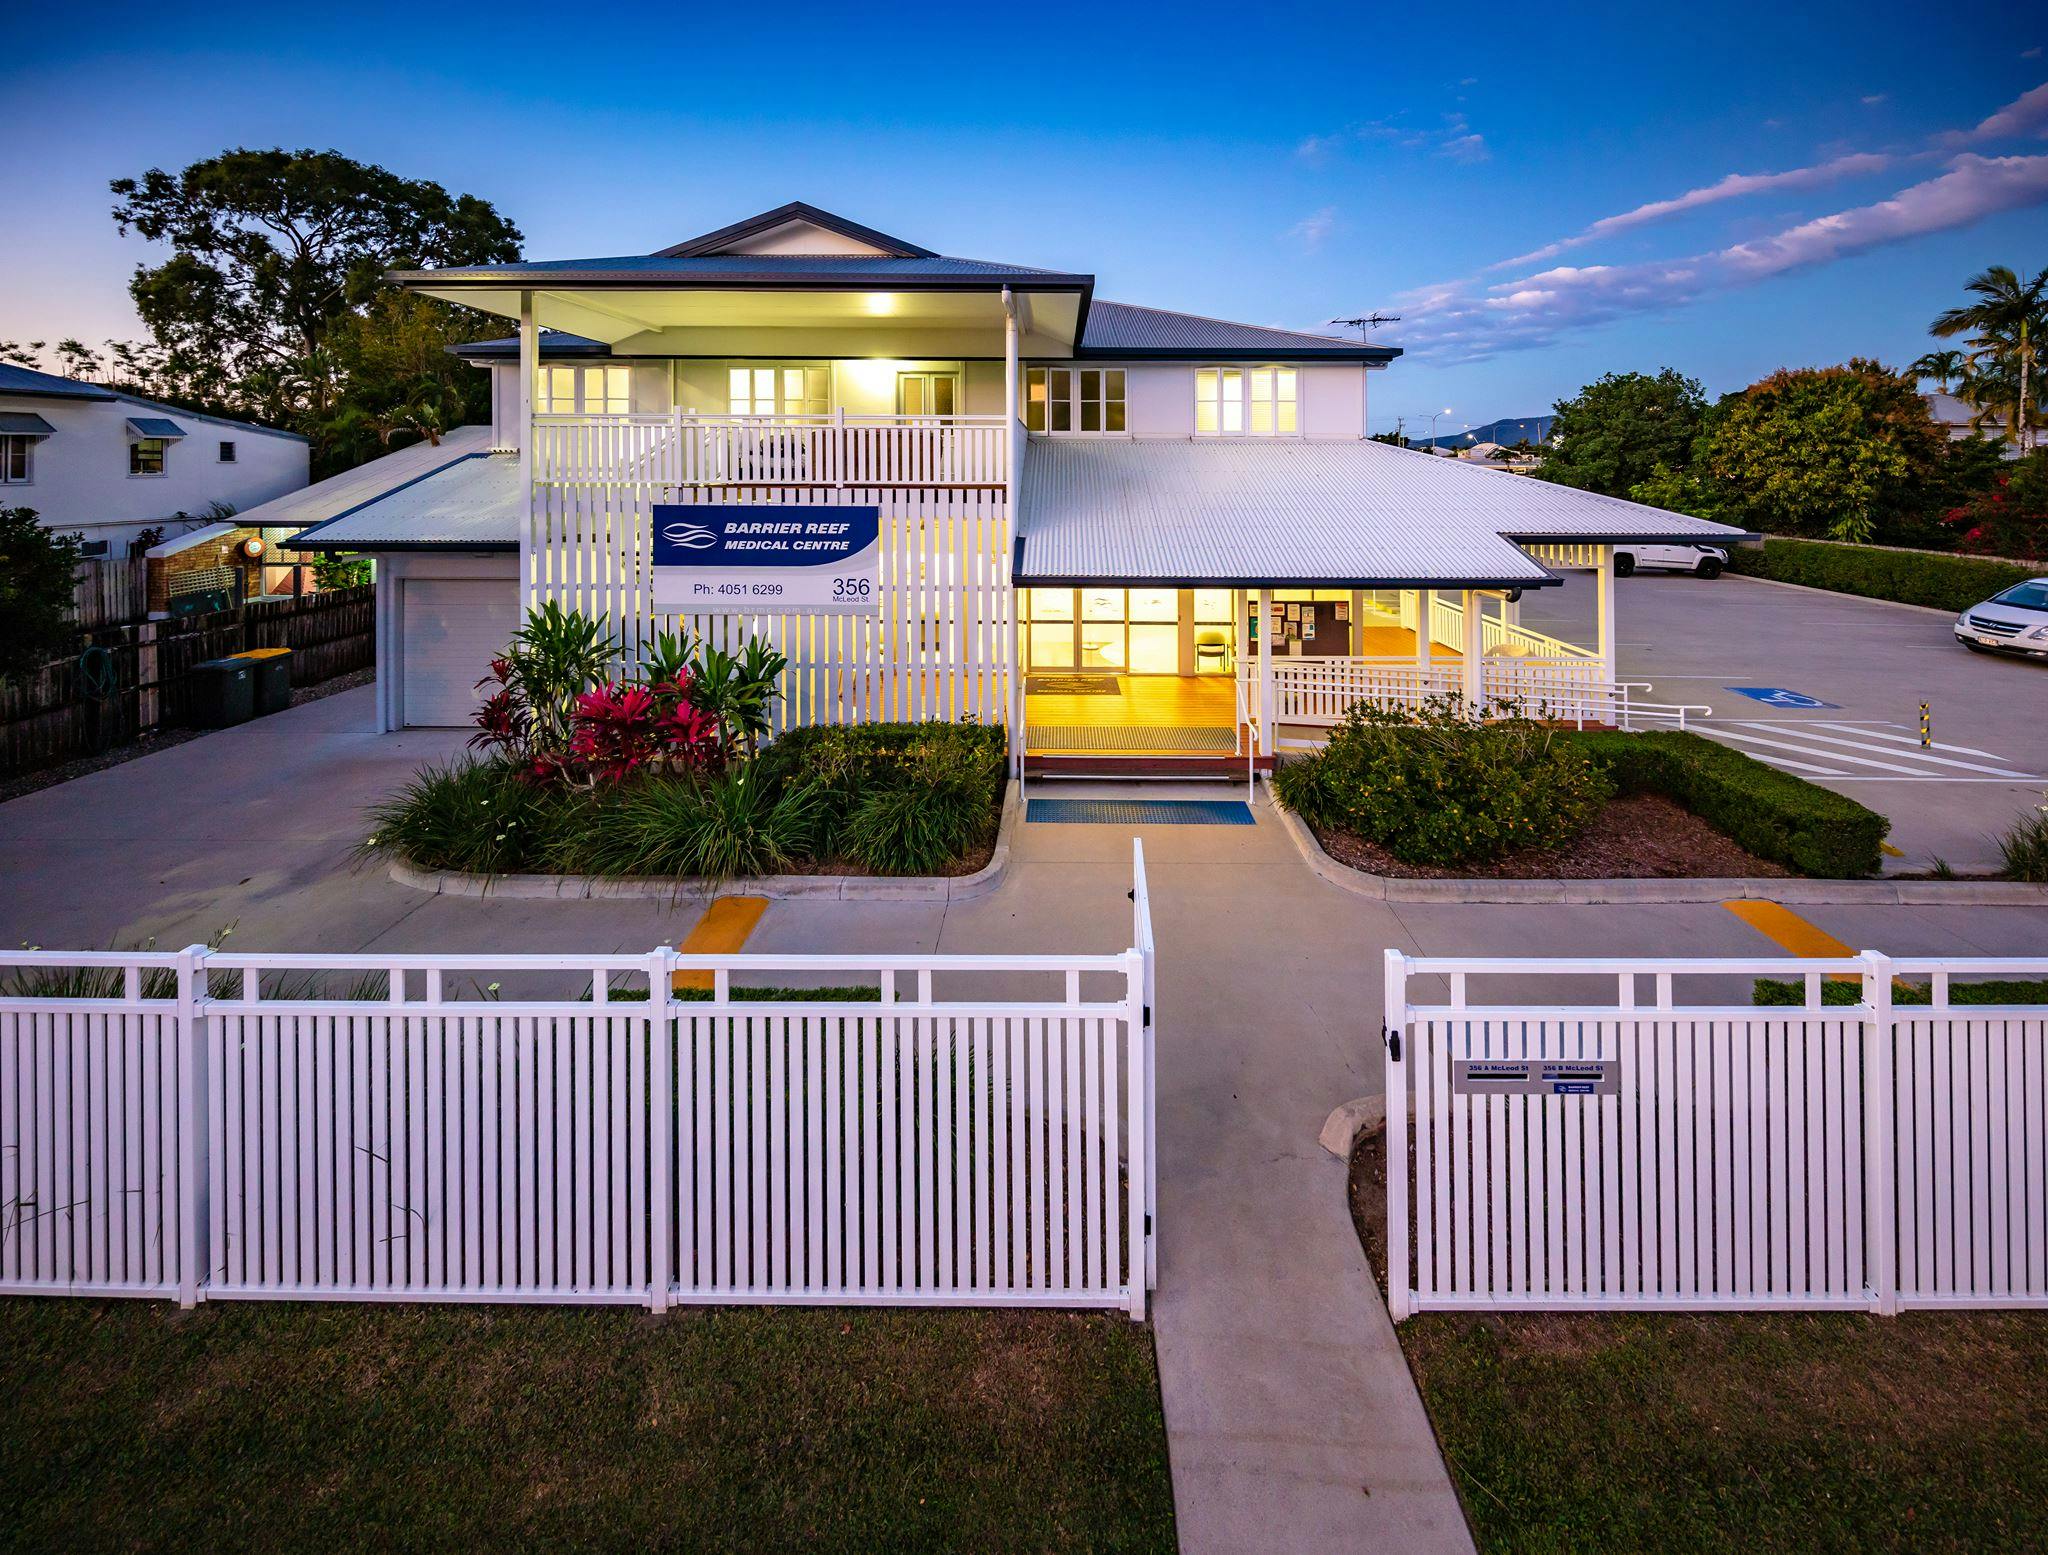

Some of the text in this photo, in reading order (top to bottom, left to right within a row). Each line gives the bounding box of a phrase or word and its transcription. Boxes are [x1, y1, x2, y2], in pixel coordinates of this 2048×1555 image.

[724, 522, 850, 535] BARRIER REEF
[724, 540, 850, 551] MEDICAL CENTRE
[693, 584, 783, 595] Ph: 4051 6299
[833, 578, 870, 595] 356
